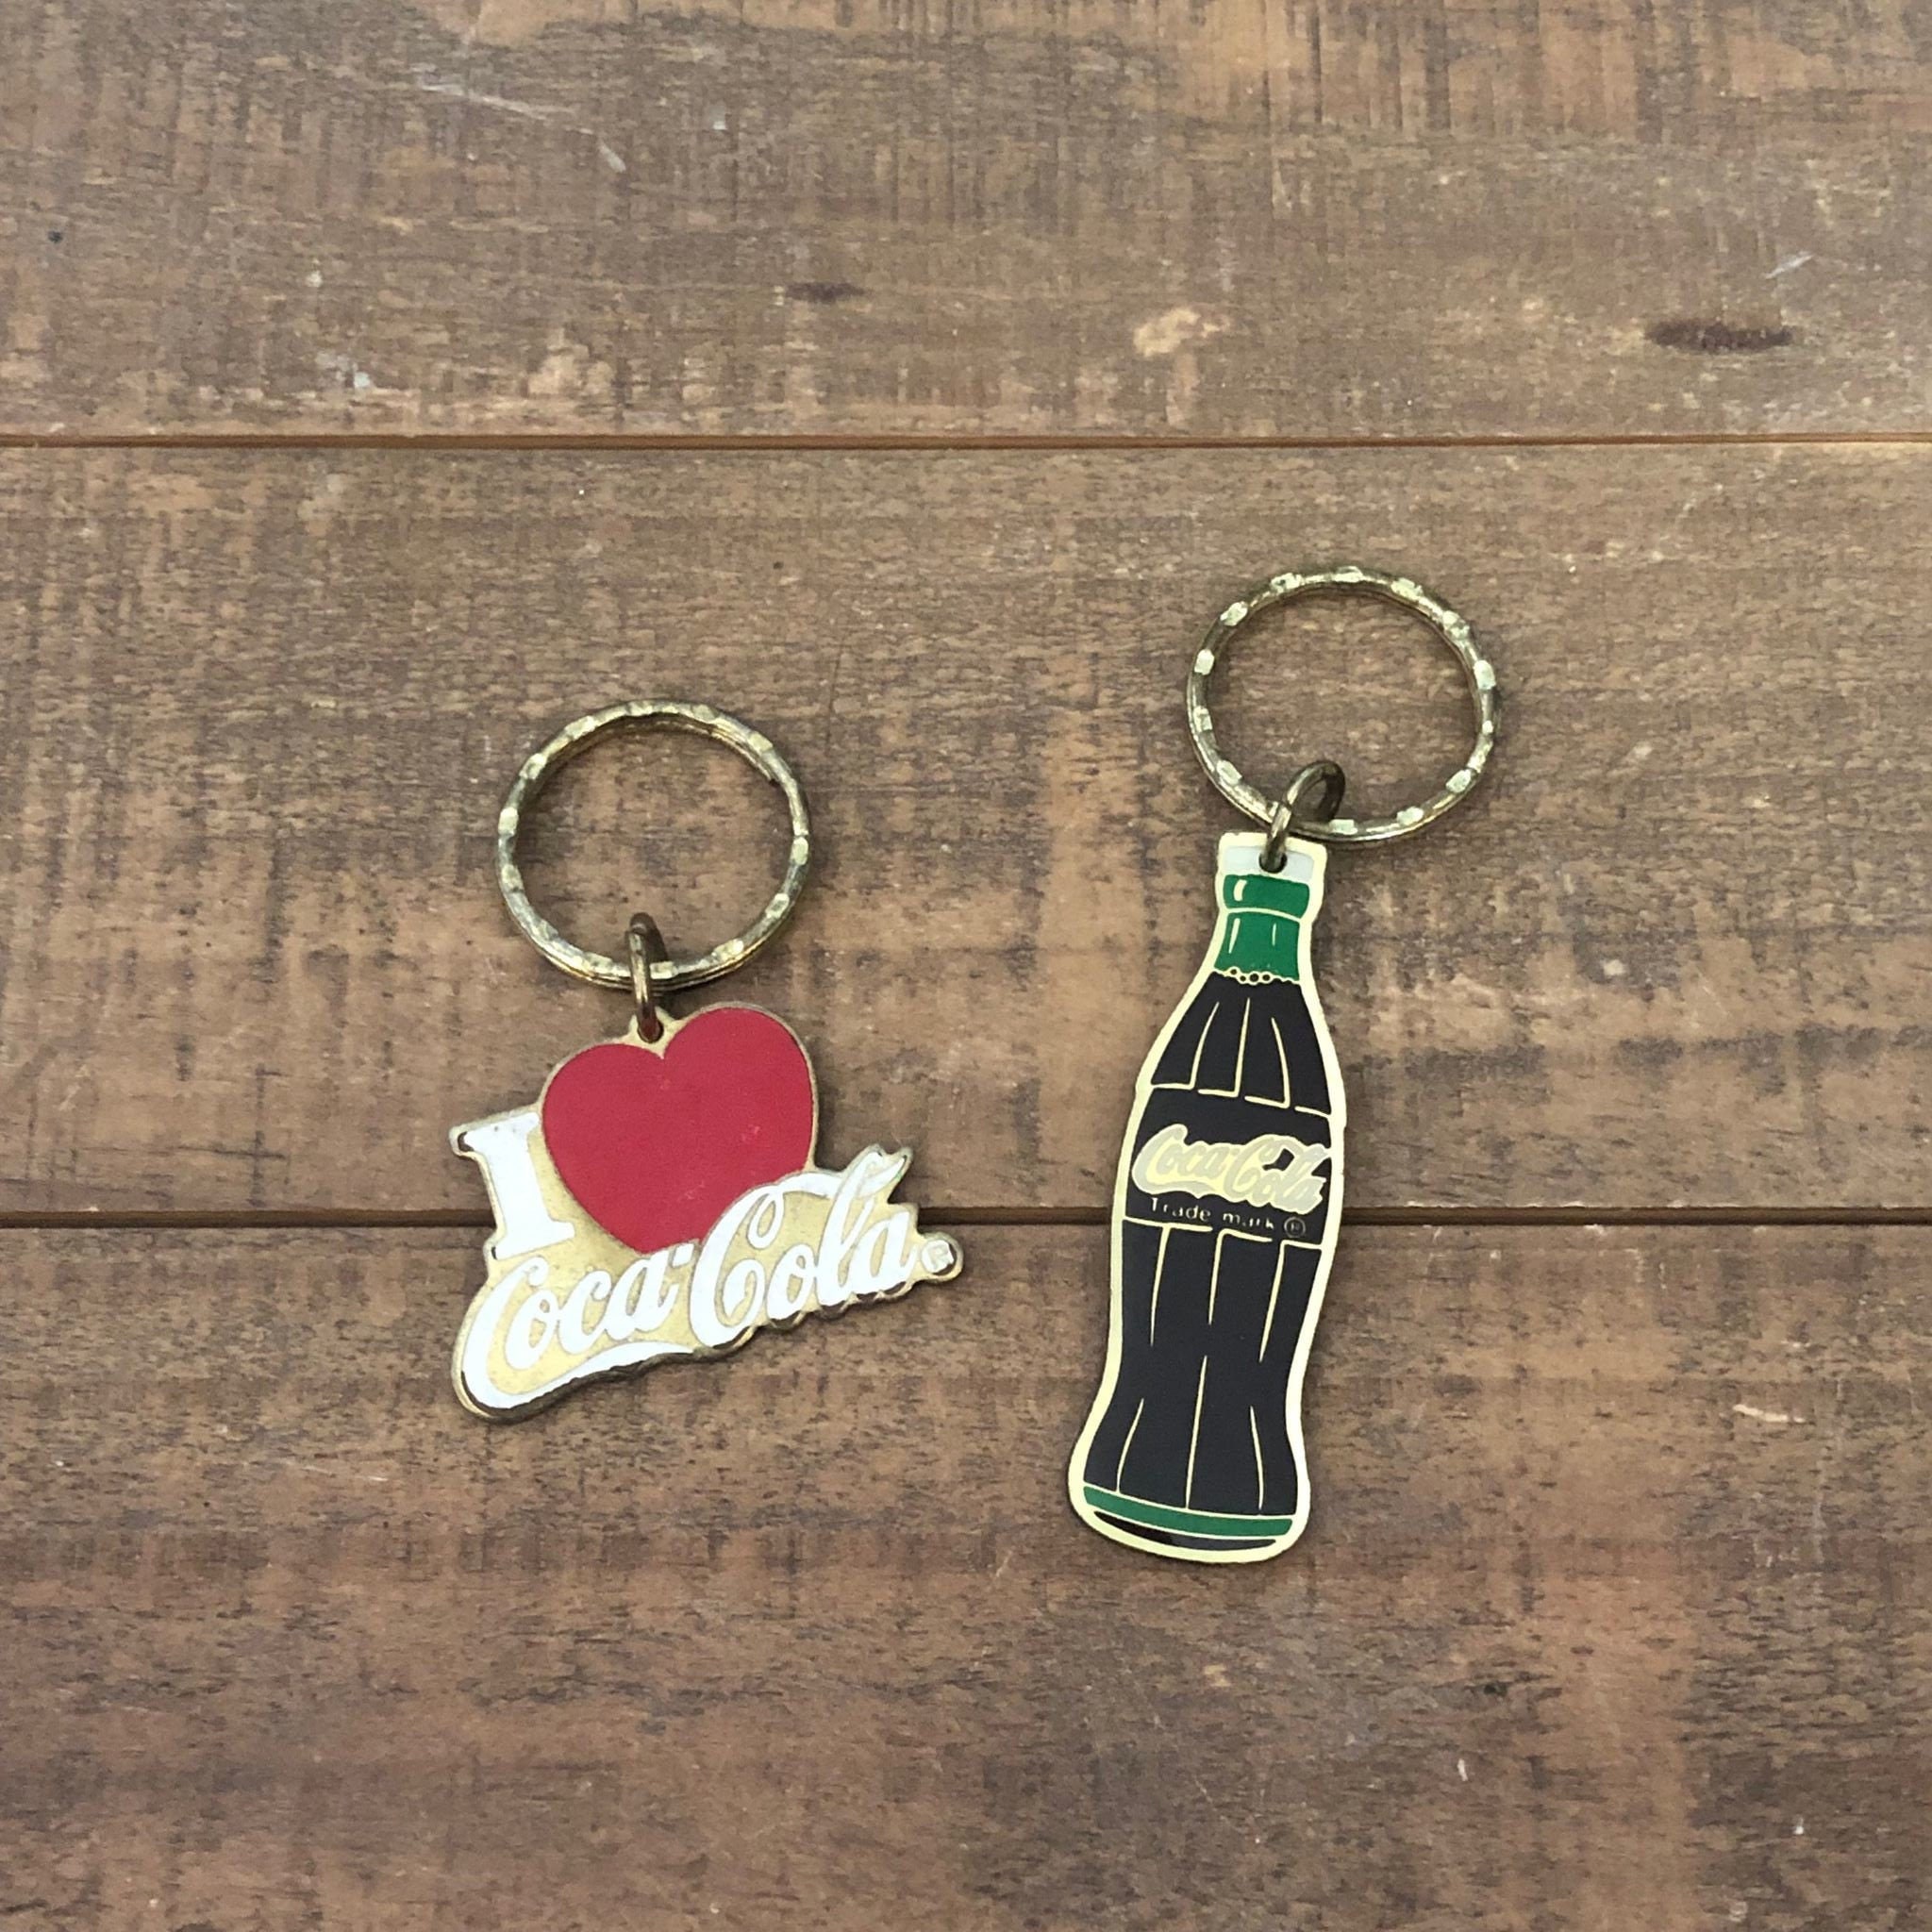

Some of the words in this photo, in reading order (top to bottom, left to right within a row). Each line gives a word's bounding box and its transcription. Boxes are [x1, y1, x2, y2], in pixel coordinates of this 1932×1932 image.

[457, 1111, 575, 1260] I
[1133, 1124, 1327, 1214] Coca-Cola
[1151, 1197, 1211, 1223] Trade
[462, 1147, 917, 1408] Coca-Cola
